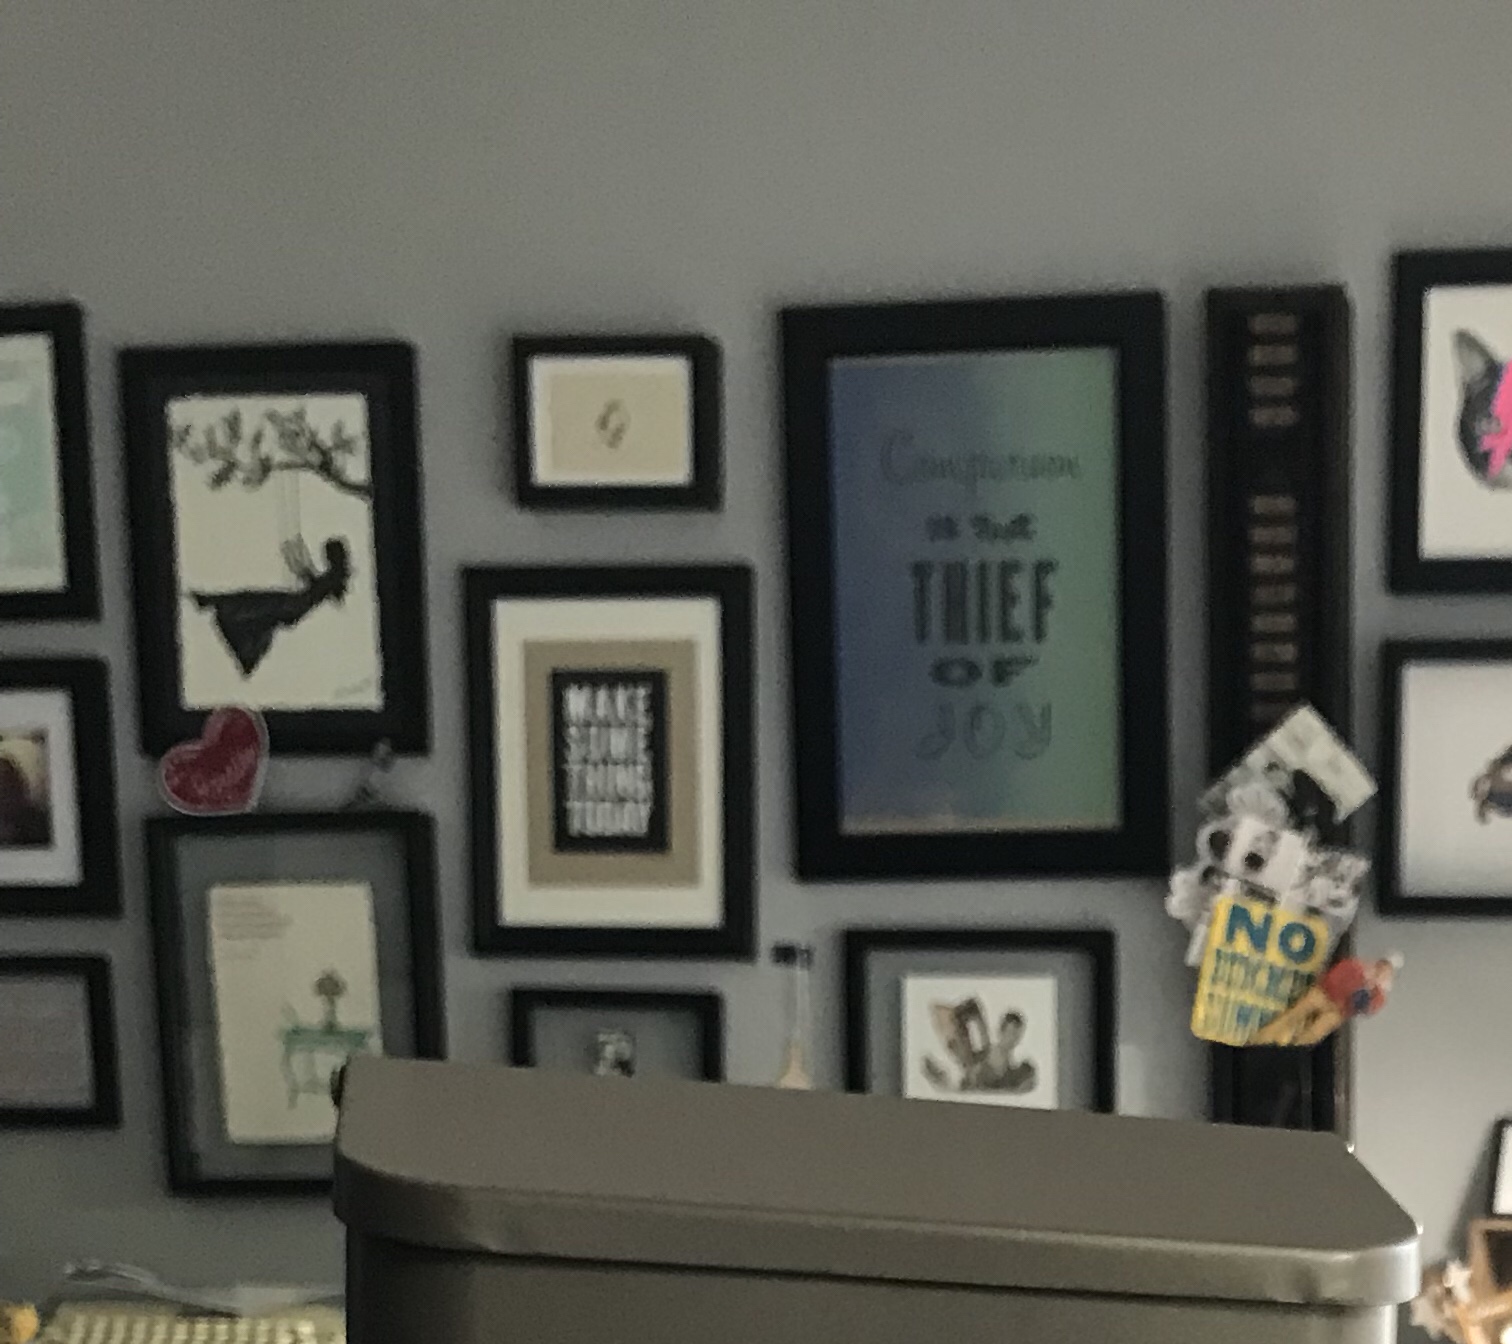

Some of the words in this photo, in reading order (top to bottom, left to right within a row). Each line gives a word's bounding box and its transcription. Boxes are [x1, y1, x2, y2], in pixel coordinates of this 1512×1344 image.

[911, 557, 1059, 646] THIEF
[928, 653, 1039, 689] OF
[1226, 903, 1317, 964] NO
